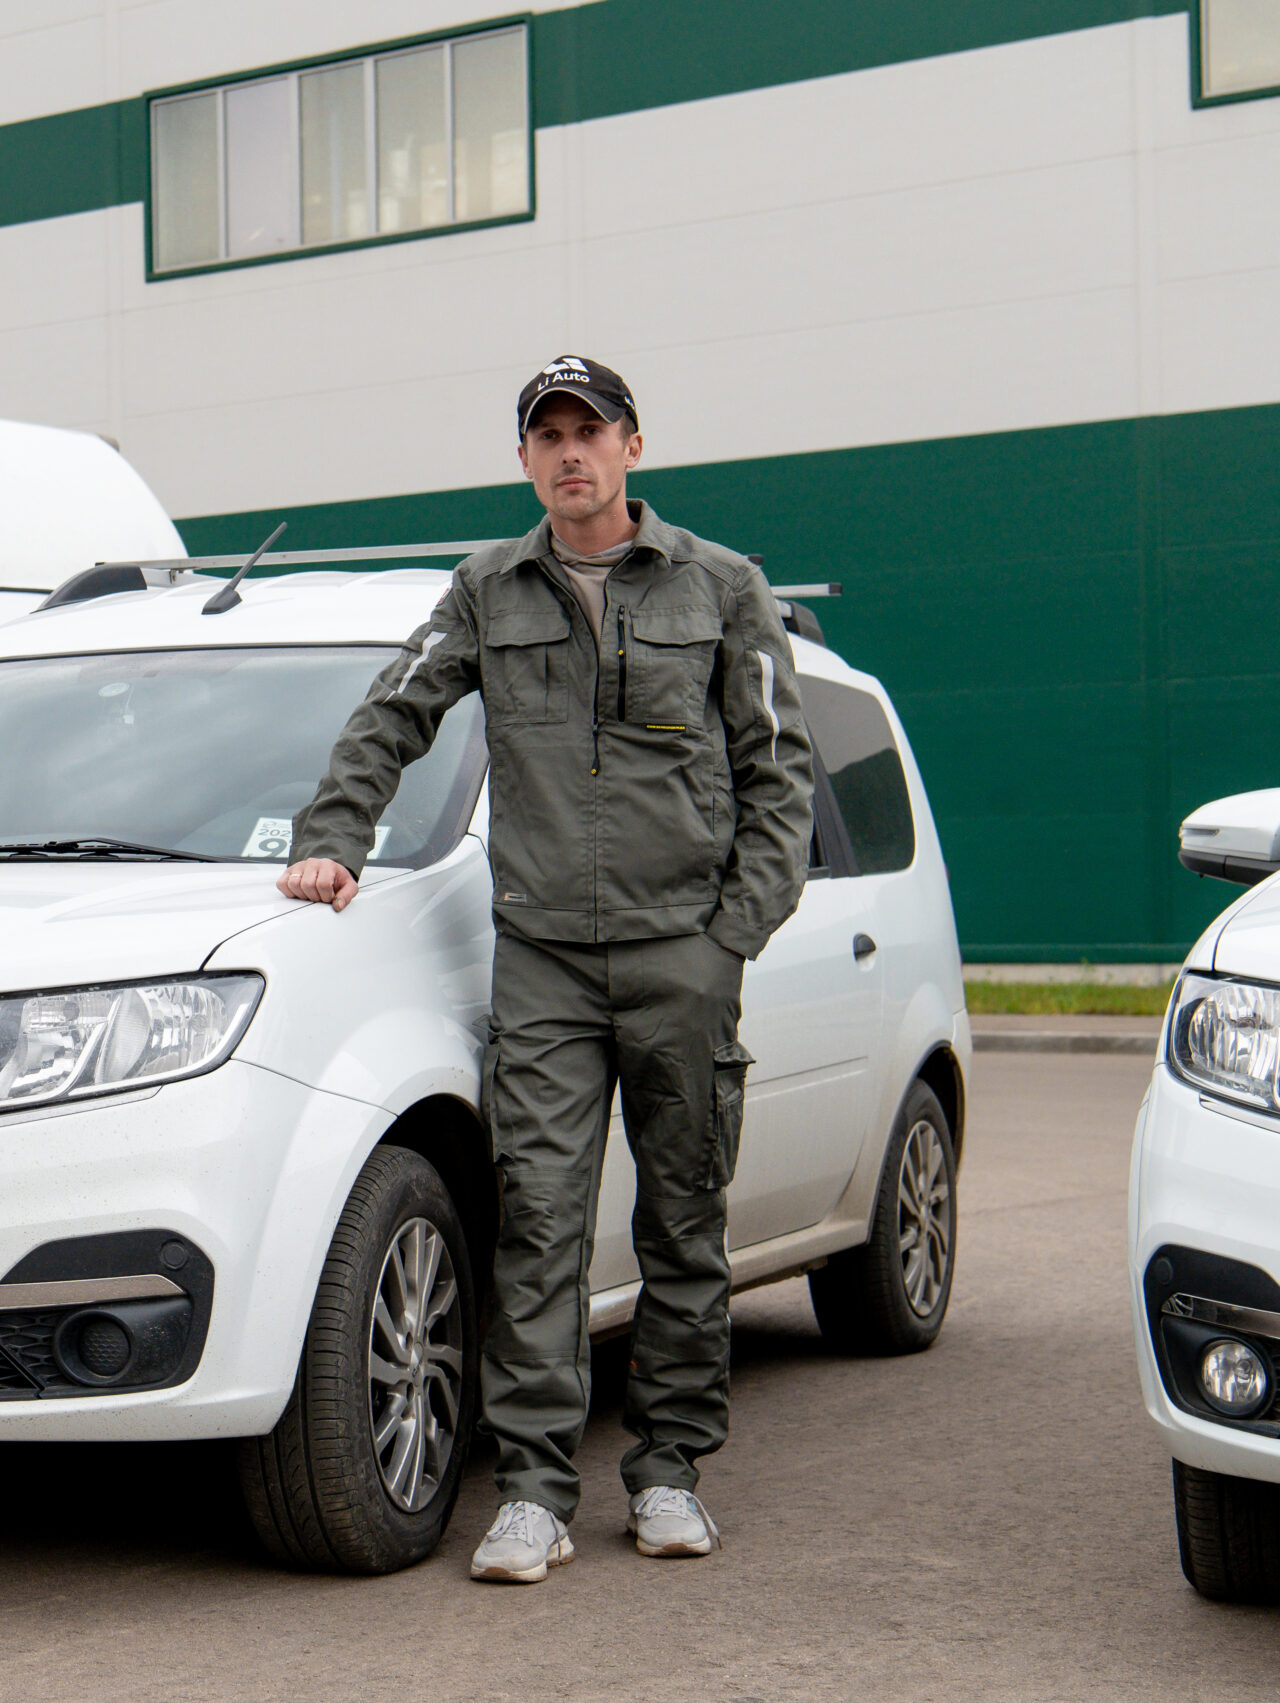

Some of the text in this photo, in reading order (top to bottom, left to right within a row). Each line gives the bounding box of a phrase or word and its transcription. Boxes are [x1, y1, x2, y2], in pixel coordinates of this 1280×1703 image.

[538, 372, 590, 391] Li Auto
[258, 828, 292, 837] 202
